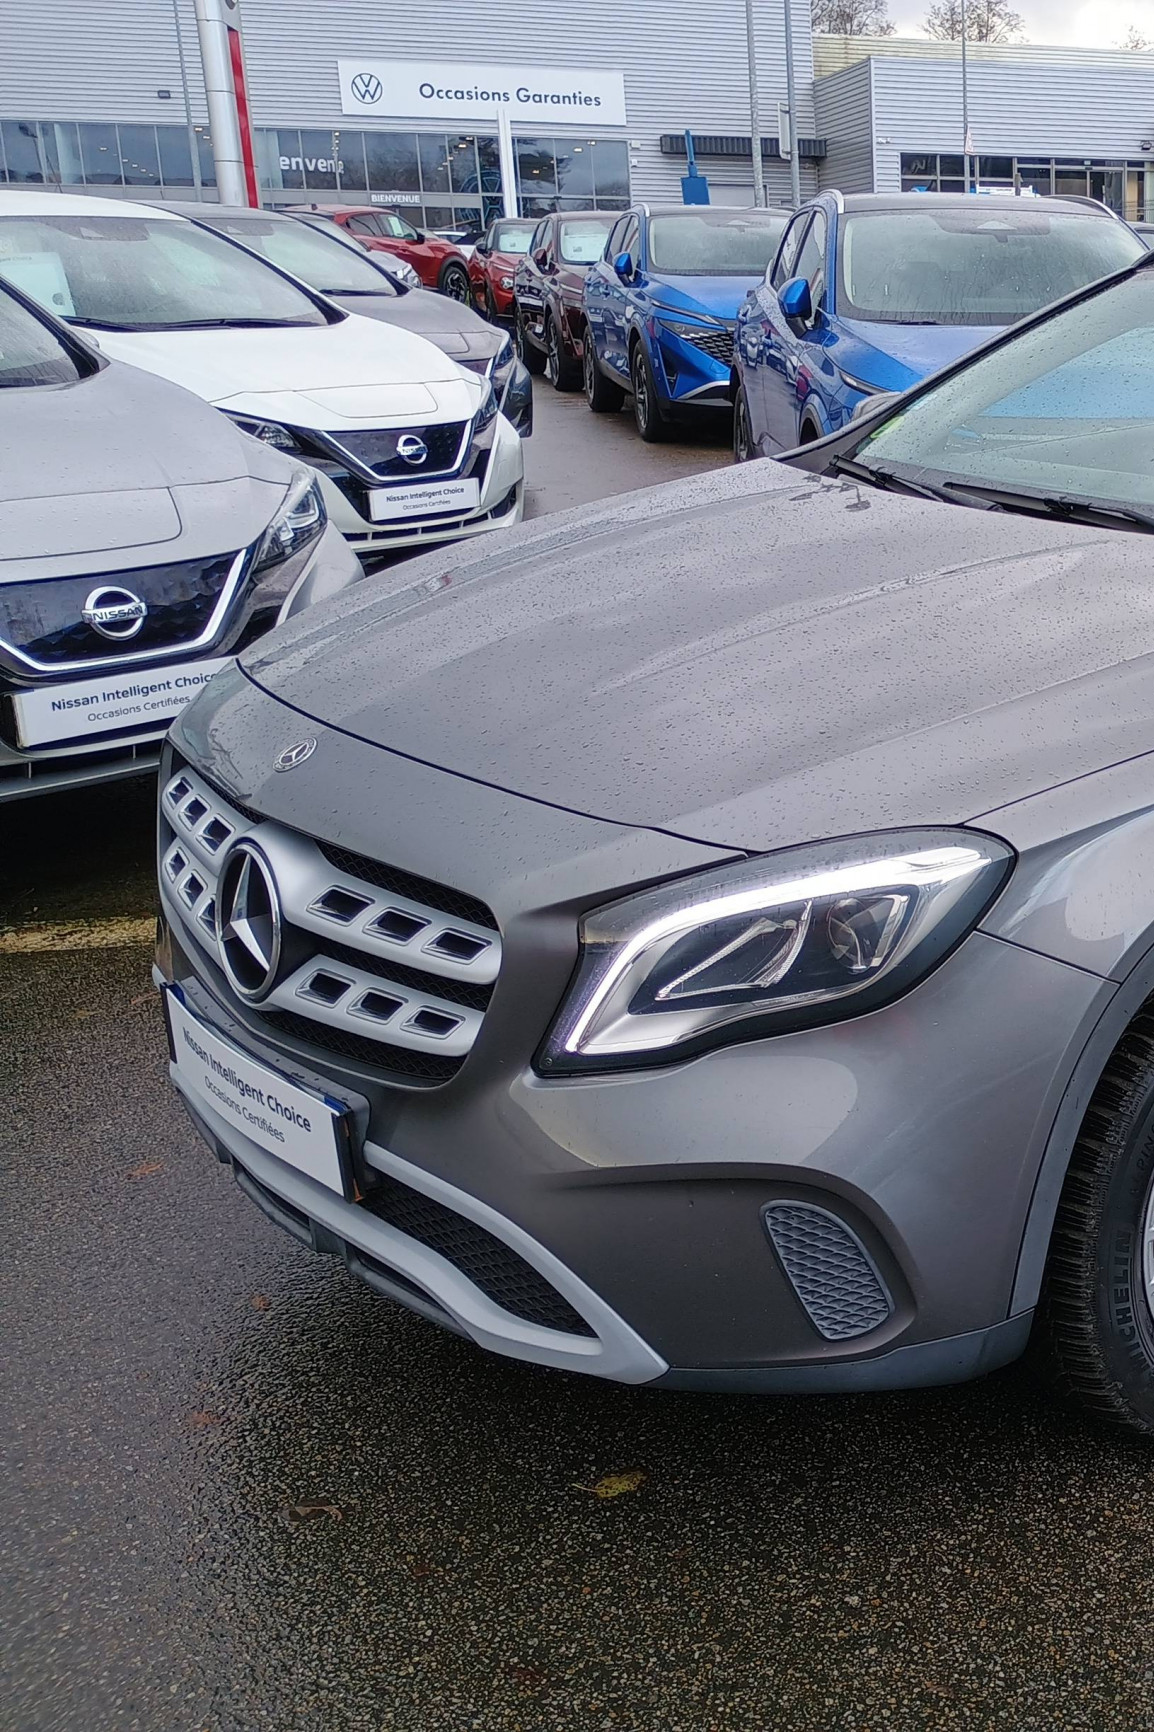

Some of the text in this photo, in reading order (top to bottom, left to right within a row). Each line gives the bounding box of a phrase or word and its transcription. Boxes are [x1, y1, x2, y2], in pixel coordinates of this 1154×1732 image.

[419, 83, 601, 106] Occasions Garanties
[371, 194, 420, 203] BIENVENUE
[386, 486, 465, 503] Nissan Intelligent Choice
[402, 502, 428, 510] Occasions
[93, 604, 143, 621] NISSAN
[51, 695, 100, 712] Nissan
[103, 680, 172, 703] Intelligent
[87, 695, 191, 722] Occasions Certifiées
[183, 1026, 312, 1132] Nissan Intelligent Choice
[204, 1075, 285, 1143] Occasions Certifiées
[1113, 1232, 1150, 1372] MICHELIN
